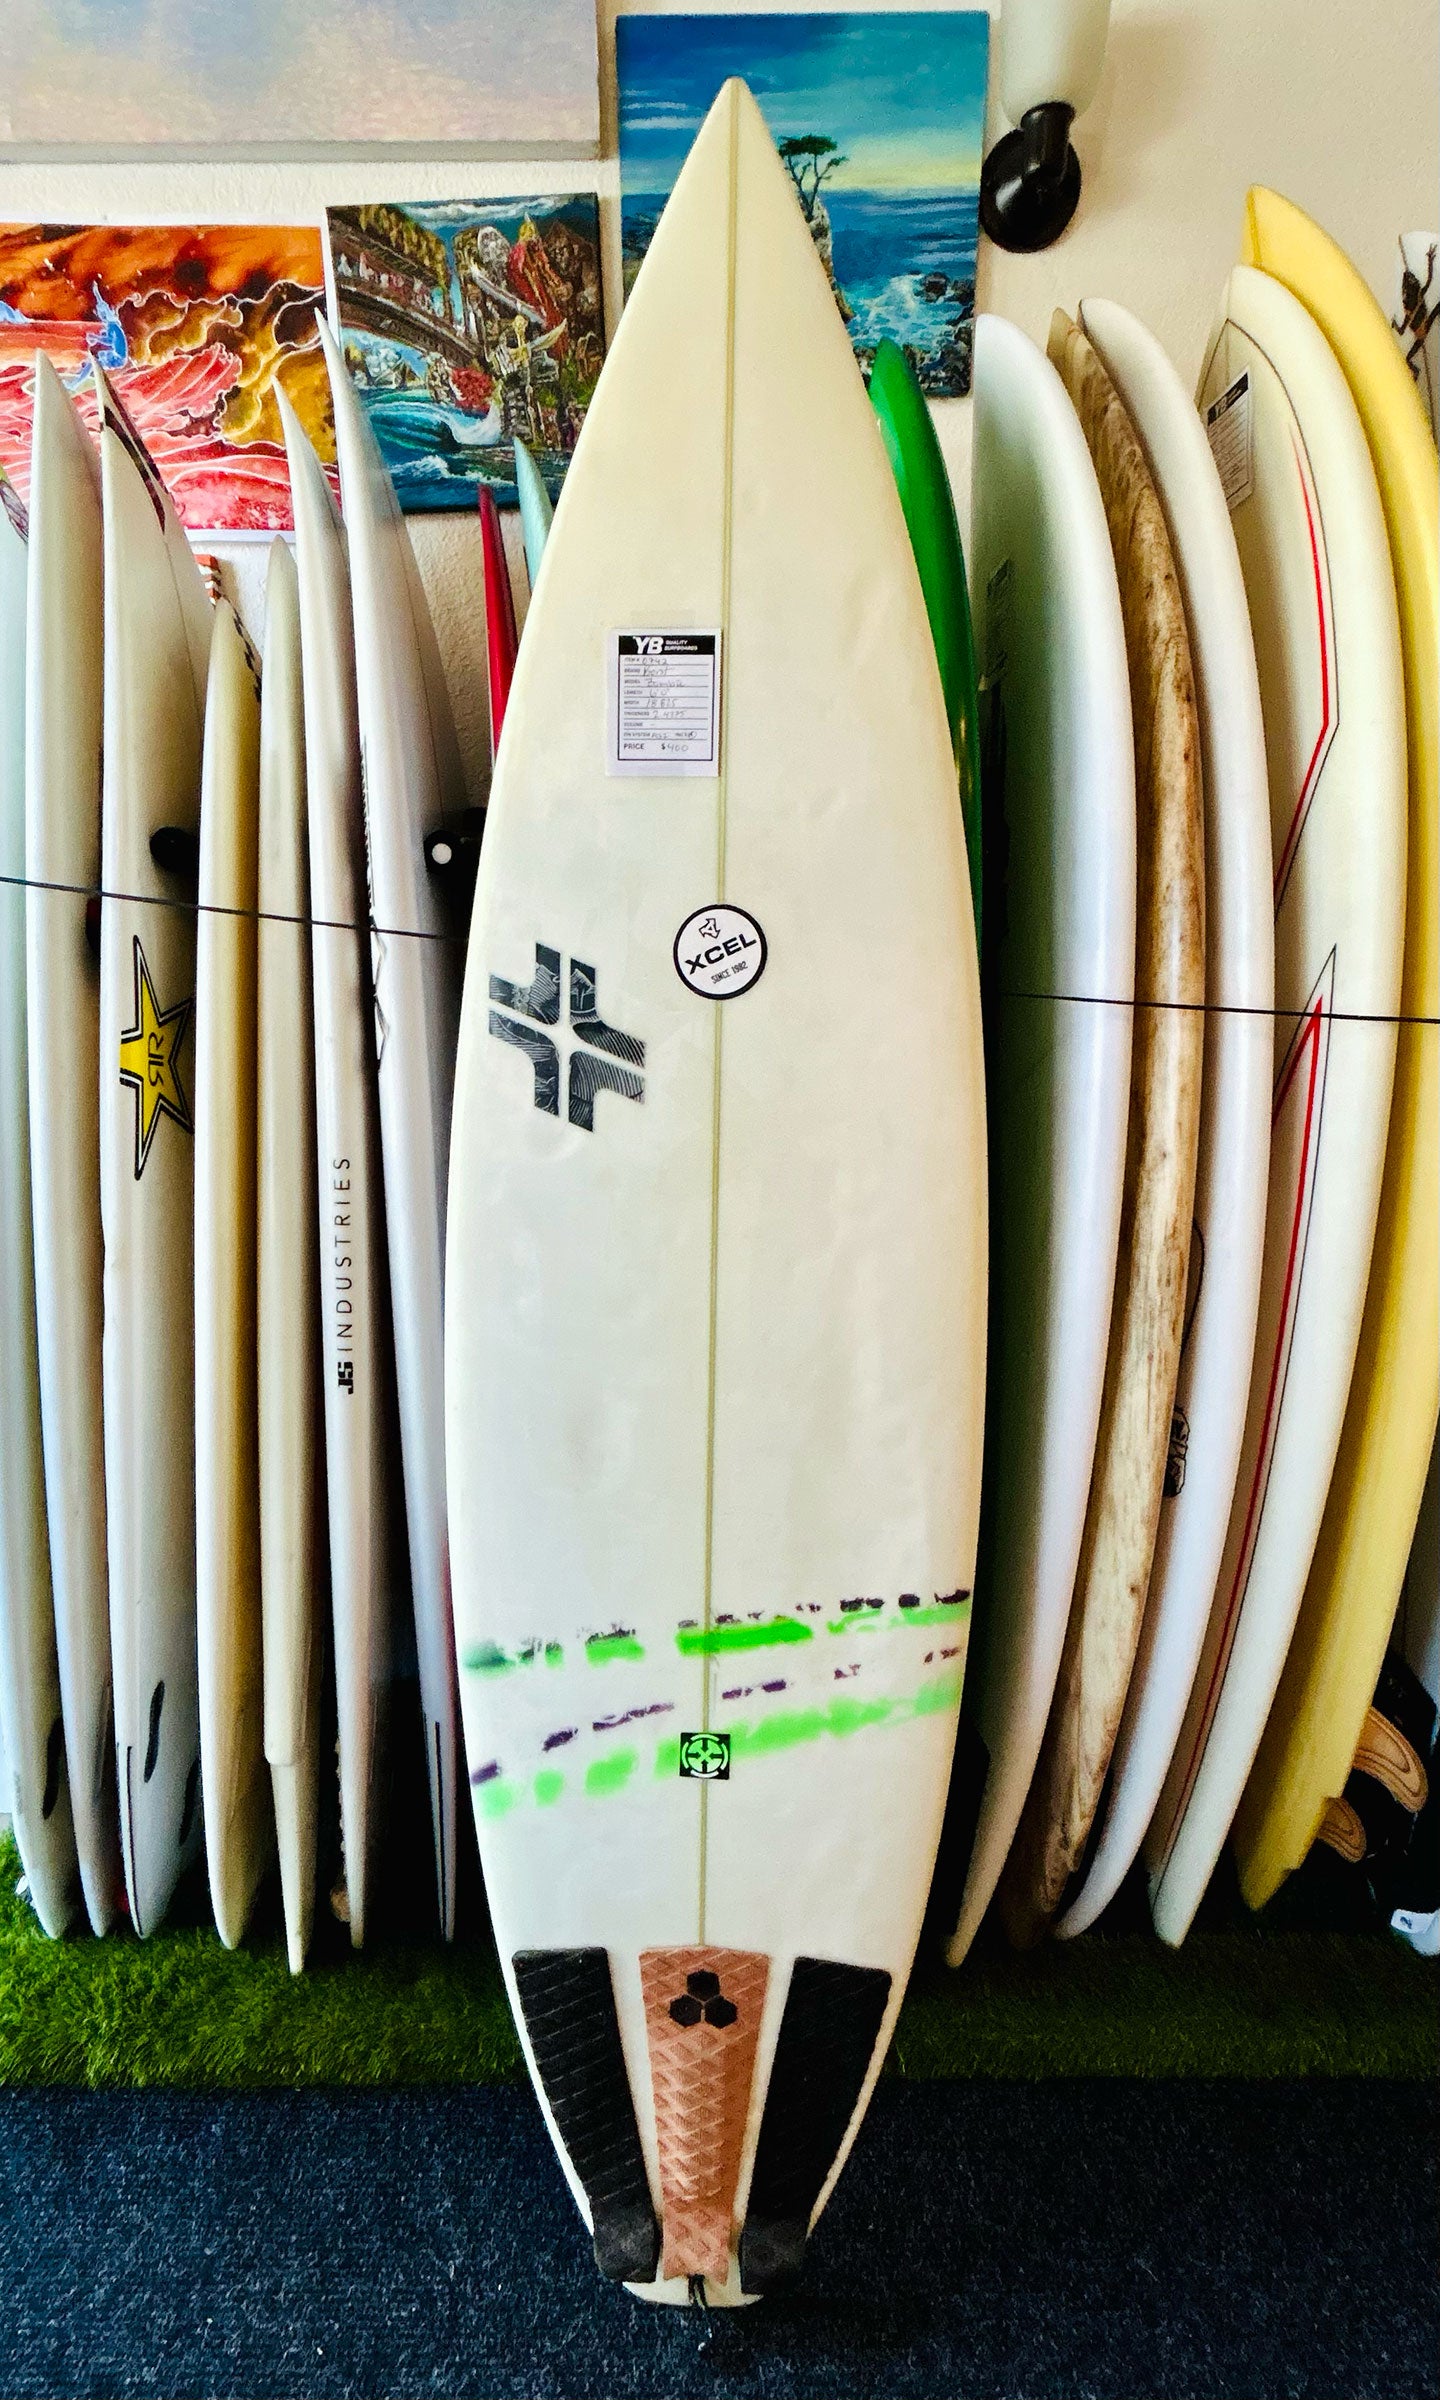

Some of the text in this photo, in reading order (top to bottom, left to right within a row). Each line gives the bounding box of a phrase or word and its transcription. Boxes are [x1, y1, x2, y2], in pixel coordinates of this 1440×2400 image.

[632, 635, 664, 655] YB
[684, 933, 757, 976] XCEL
[710, 961, 749, 985] SINCE 1982
[333, 1158, 354, 1395] JS INDUSTRIES
